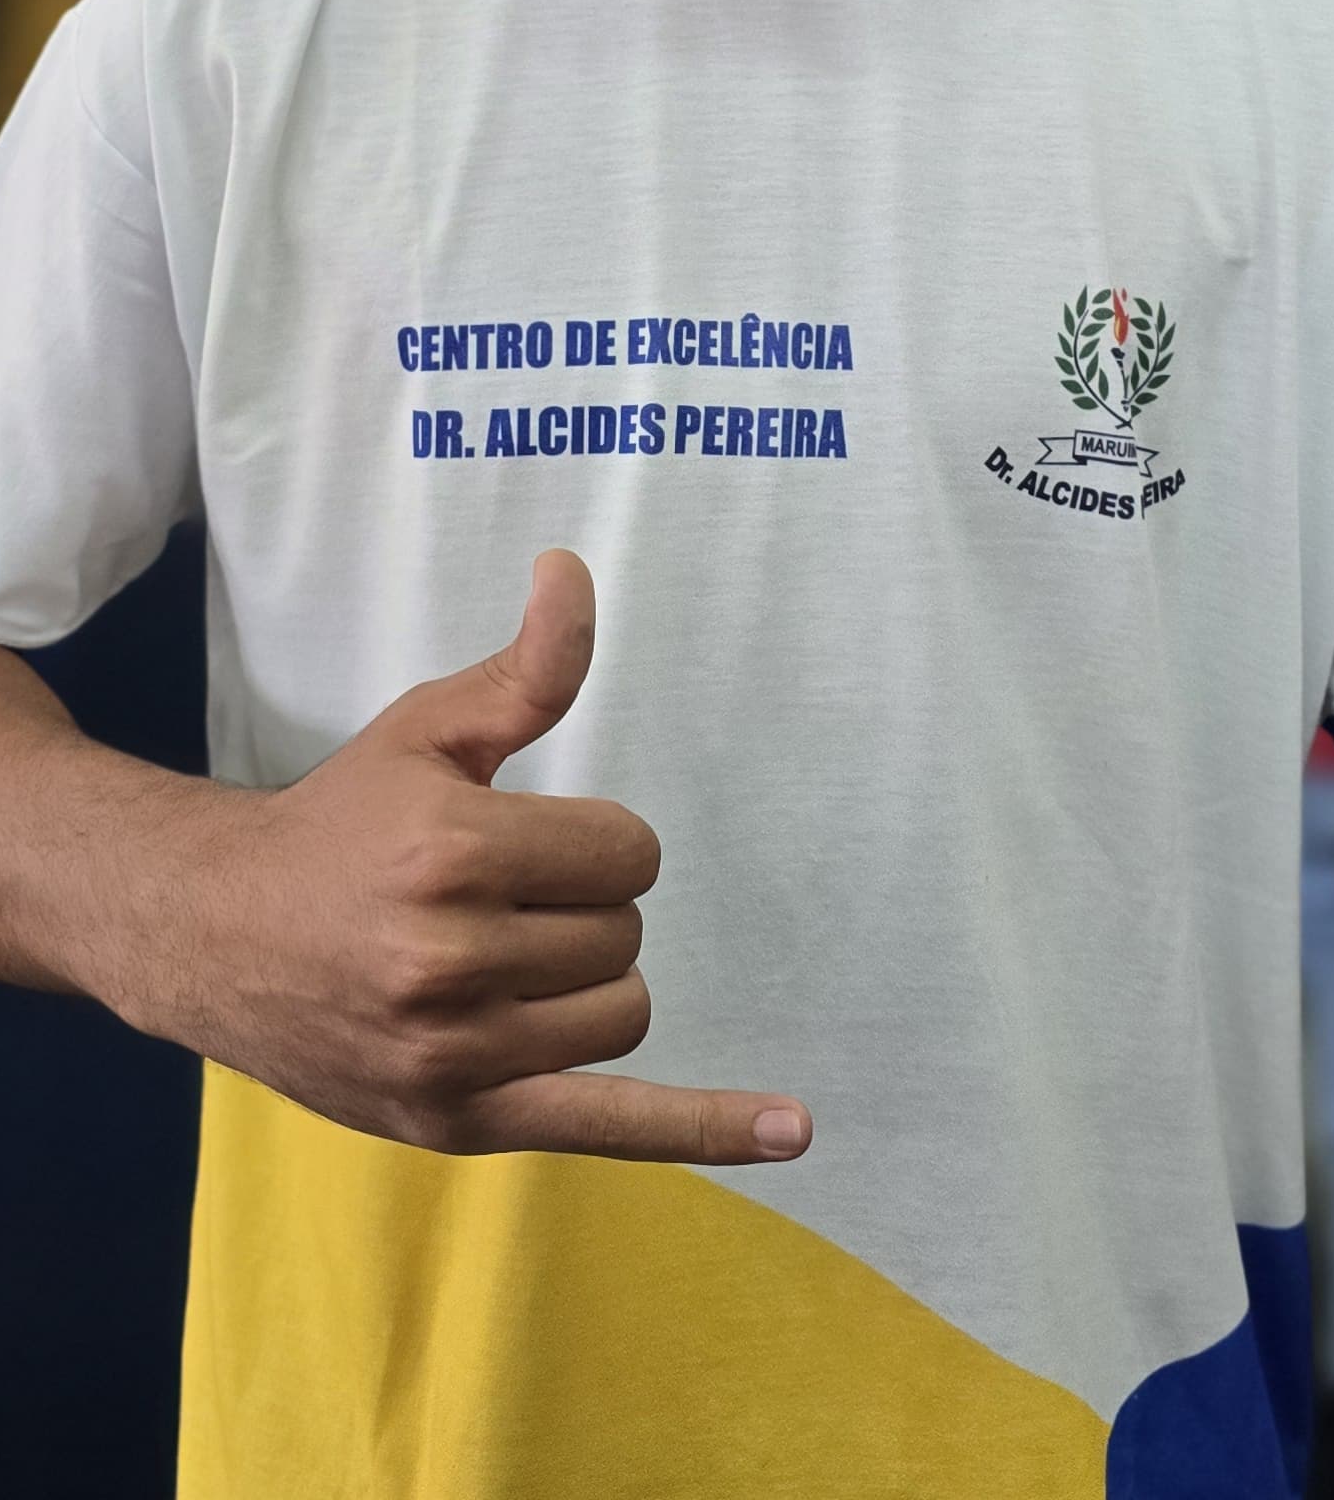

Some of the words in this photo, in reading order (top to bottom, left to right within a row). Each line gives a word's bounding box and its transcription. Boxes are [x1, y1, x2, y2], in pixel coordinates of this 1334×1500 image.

[397, 321, 553, 372] CENTRO
[565, 320, 616, 367] DE
[628, 313, 853, 371] EXCELÊNCIA
[412, 409, 475, 459] DR.
[485, 403, 666, 458] ALCIDES
[674, 404, 848, 459] PEREIRA
[984, 446, 1013, 484] Dr.
[1017, 469, 1135, 520] ALCIDES
